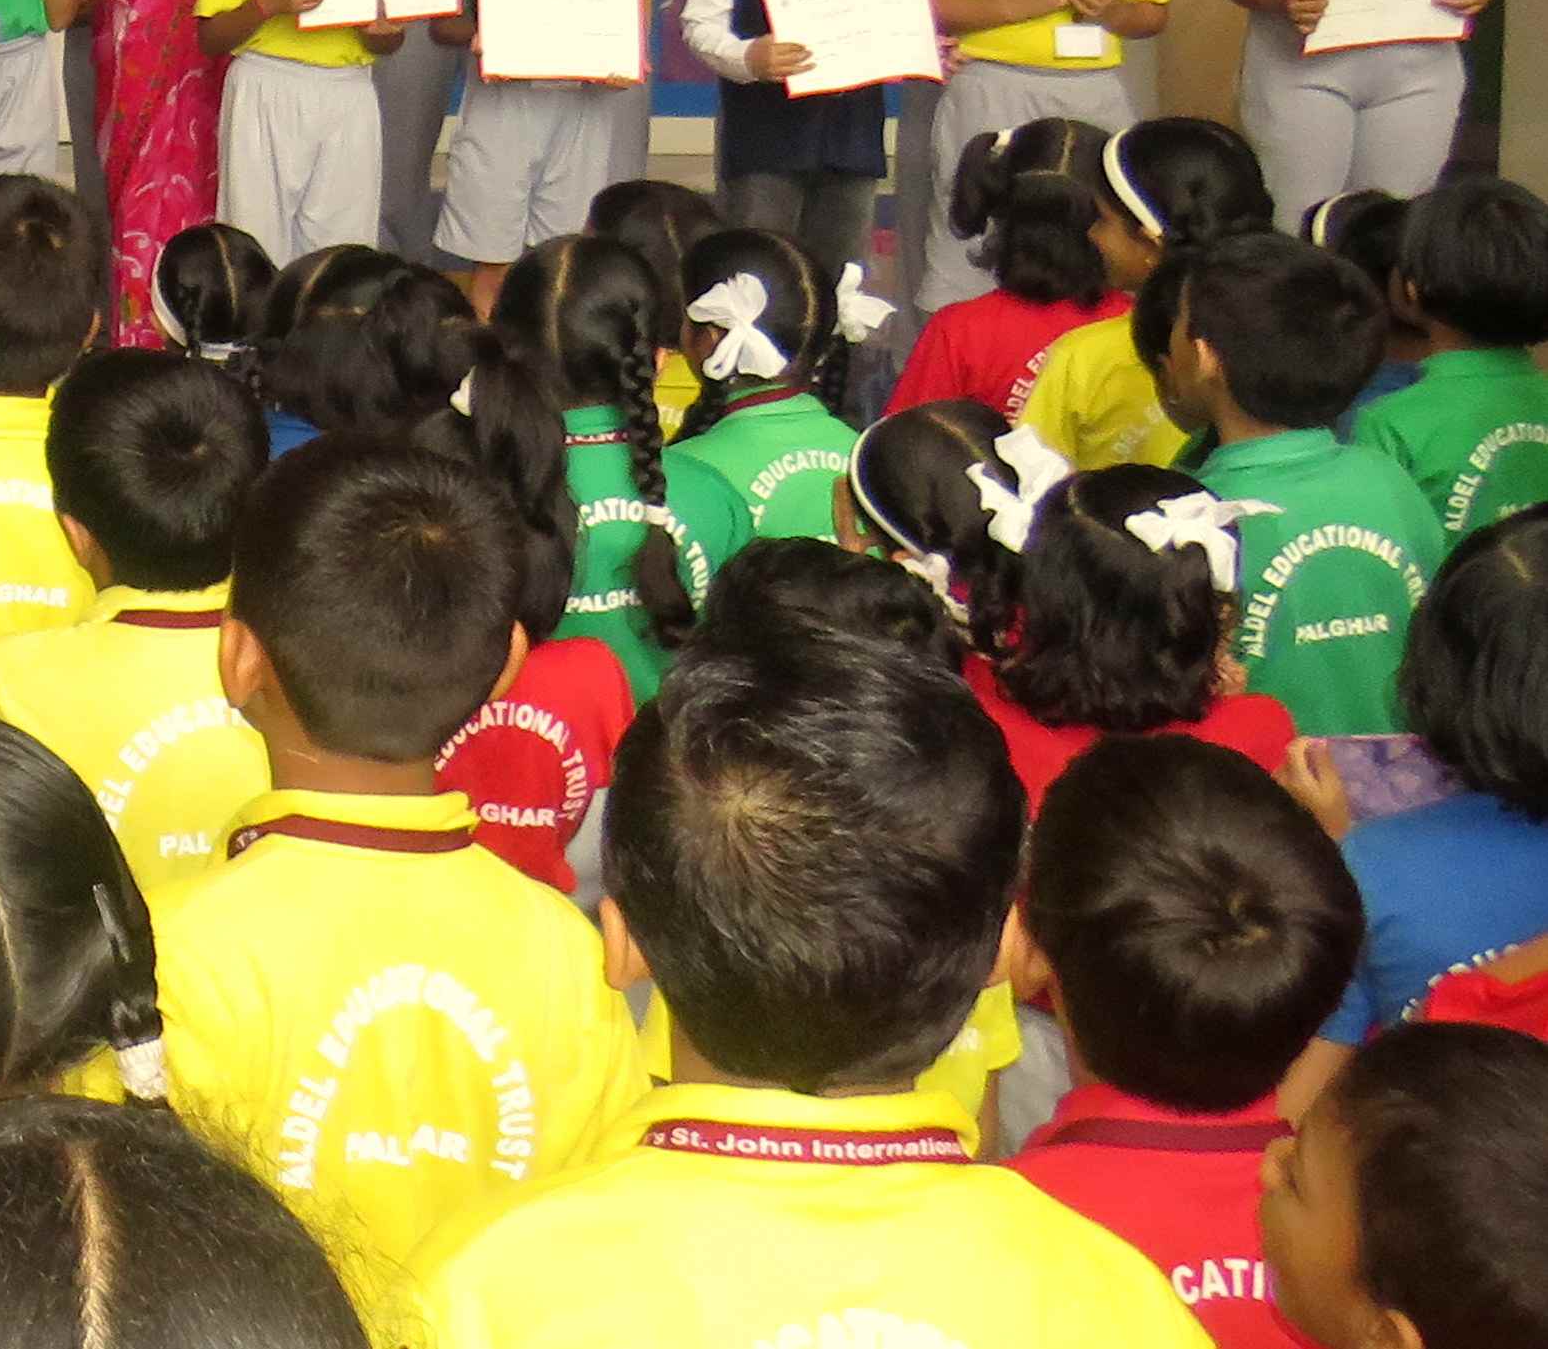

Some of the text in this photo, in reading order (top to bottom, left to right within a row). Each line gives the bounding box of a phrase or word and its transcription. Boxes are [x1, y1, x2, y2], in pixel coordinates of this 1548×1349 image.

[1468, 422, 1548, 472] EDUCATIO
[756, 449, 852, 500] EDUCATIO
[1238, 590, 1279, 659] ALDEL
[1261, 523, 1405, 589] EDUCATIONAL
[479, 803, 556, 827] GHAR
[276, 1073, 337, 1190] ALDEL
[490, 1058, 535, 1182] TRUST
[670, 1127, 709, 1150] St.
[716, 1133, 804, 1158] John
[812, 1138, 963, 1160] Internation
